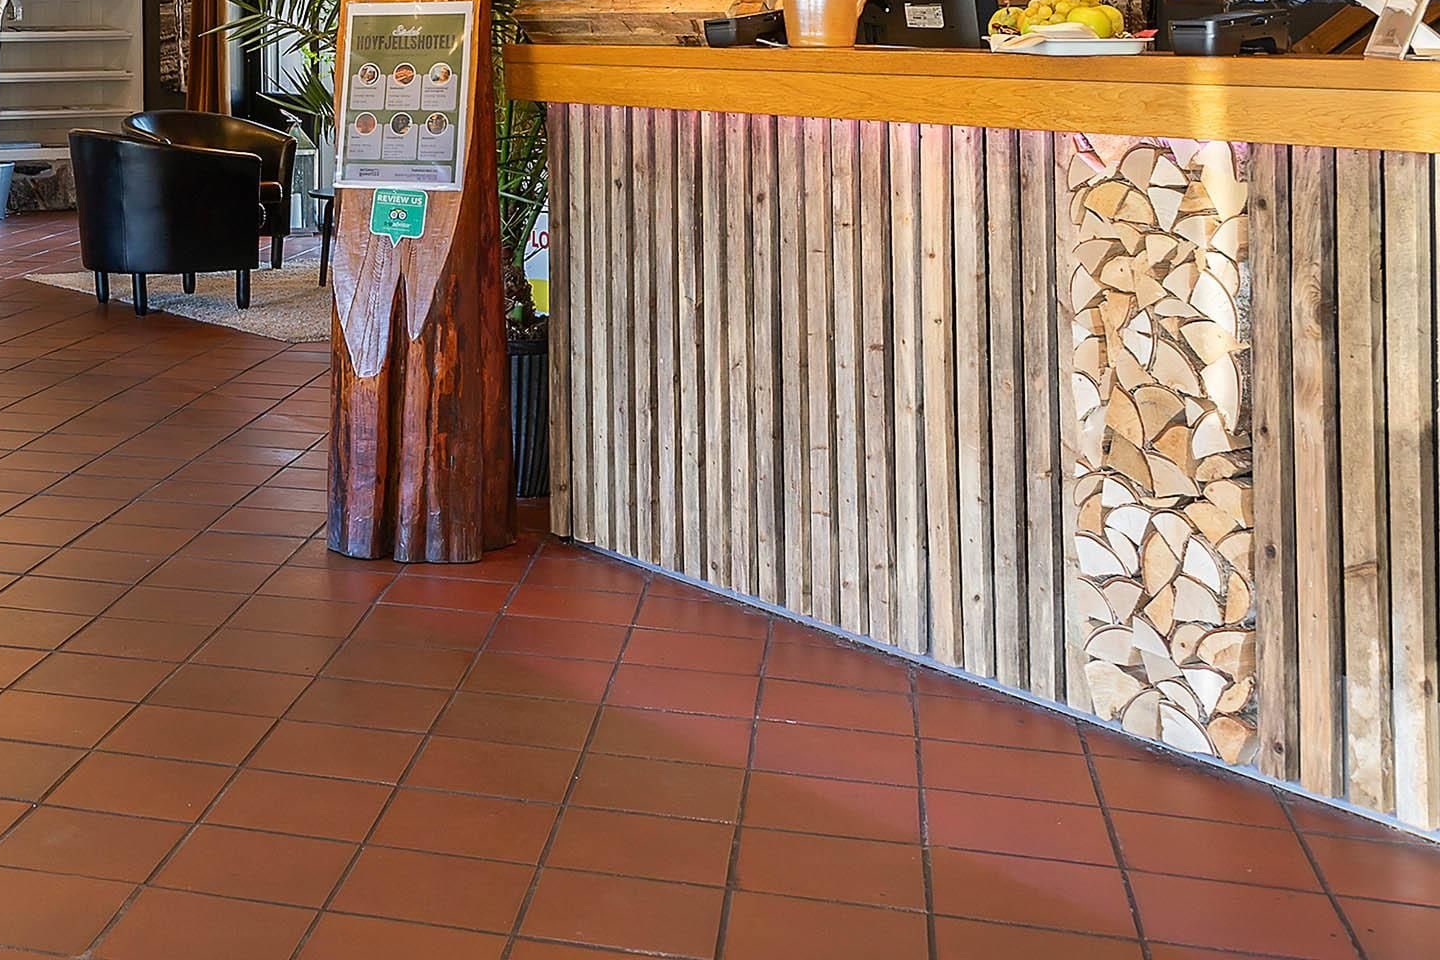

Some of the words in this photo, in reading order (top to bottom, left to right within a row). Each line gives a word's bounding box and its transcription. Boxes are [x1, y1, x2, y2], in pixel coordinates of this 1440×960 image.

[376, 194, 410, 203] REVIEW
[410, 197, 423, 205] US
[528, 230, 550, 249] LO
